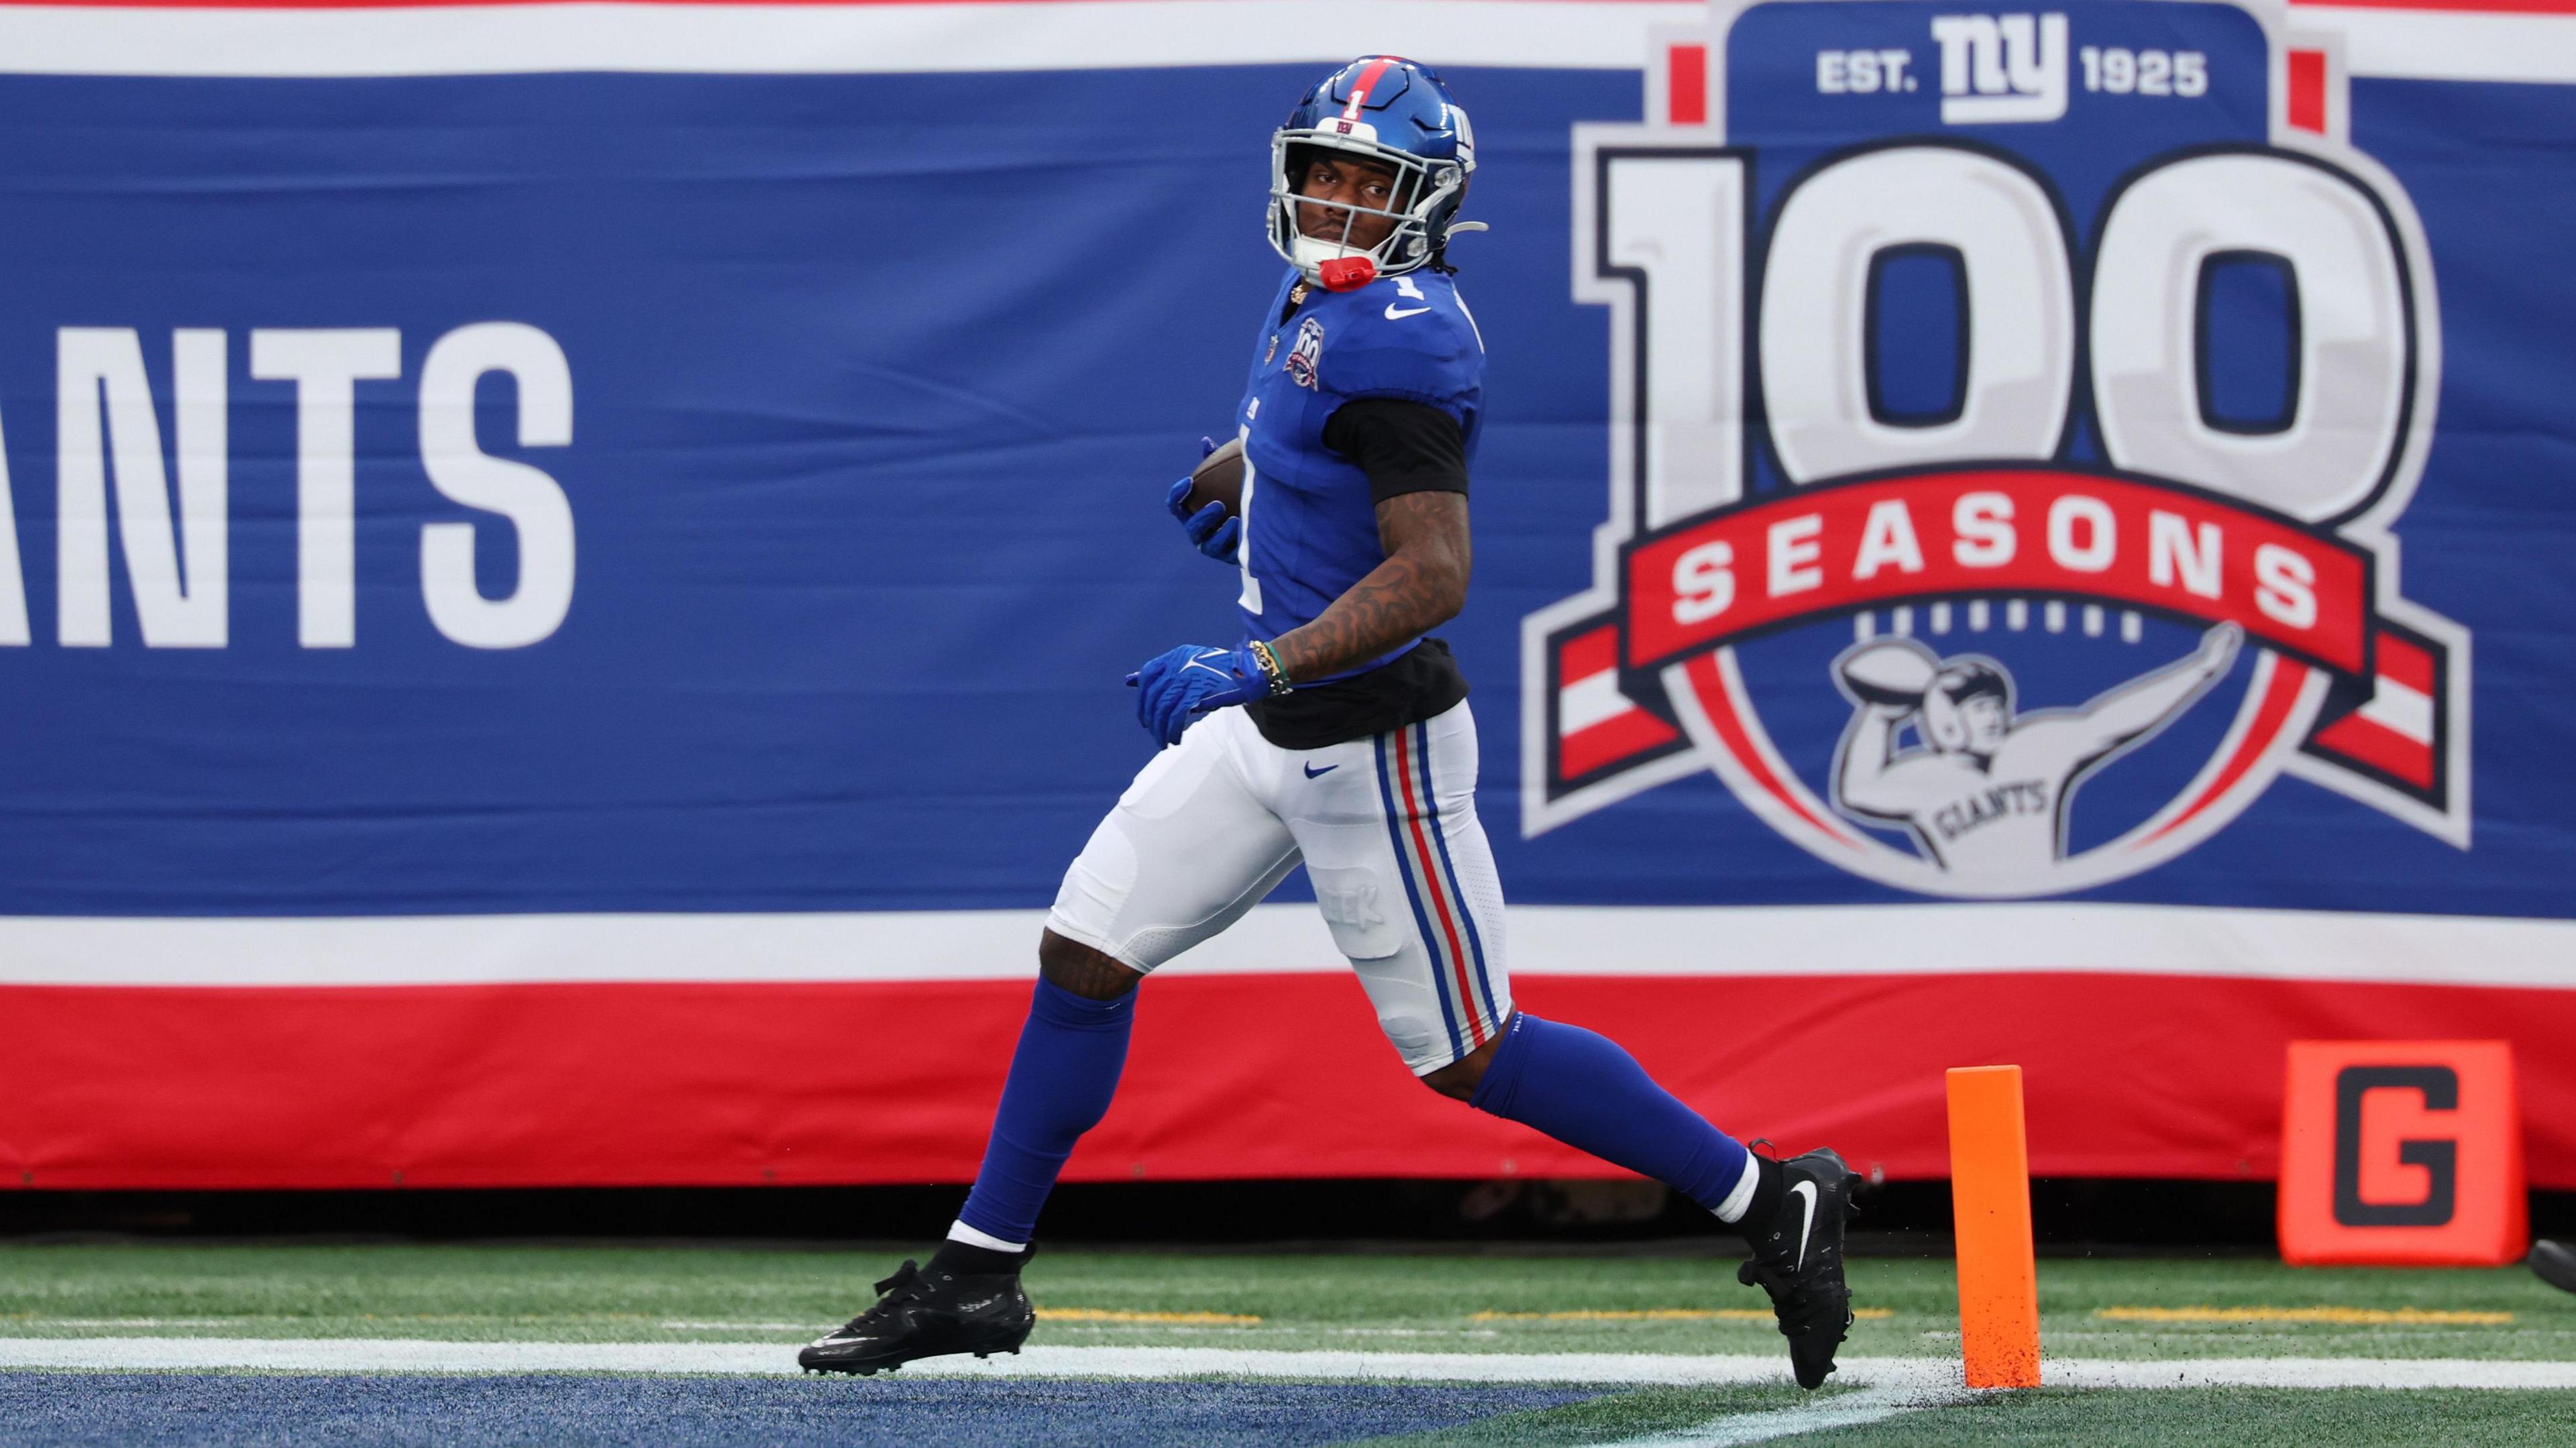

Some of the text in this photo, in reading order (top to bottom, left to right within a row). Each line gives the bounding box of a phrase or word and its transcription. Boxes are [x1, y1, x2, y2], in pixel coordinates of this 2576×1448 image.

[1342, 90, 1364, 119] 1
[1817, 50, 1917, 93] EST.
[2081, 47, 2208, 97] 1925
[1390, 276, 1425, 301] 1
[1605, 142, 2410, 531] 100
[0, 321, 576, 649] NTS
[1672, 492, 2317, 629] SEASONS
[1932, 779, 2048, 840] GIANTS
[2333, 1066, 2459, 1227] G
